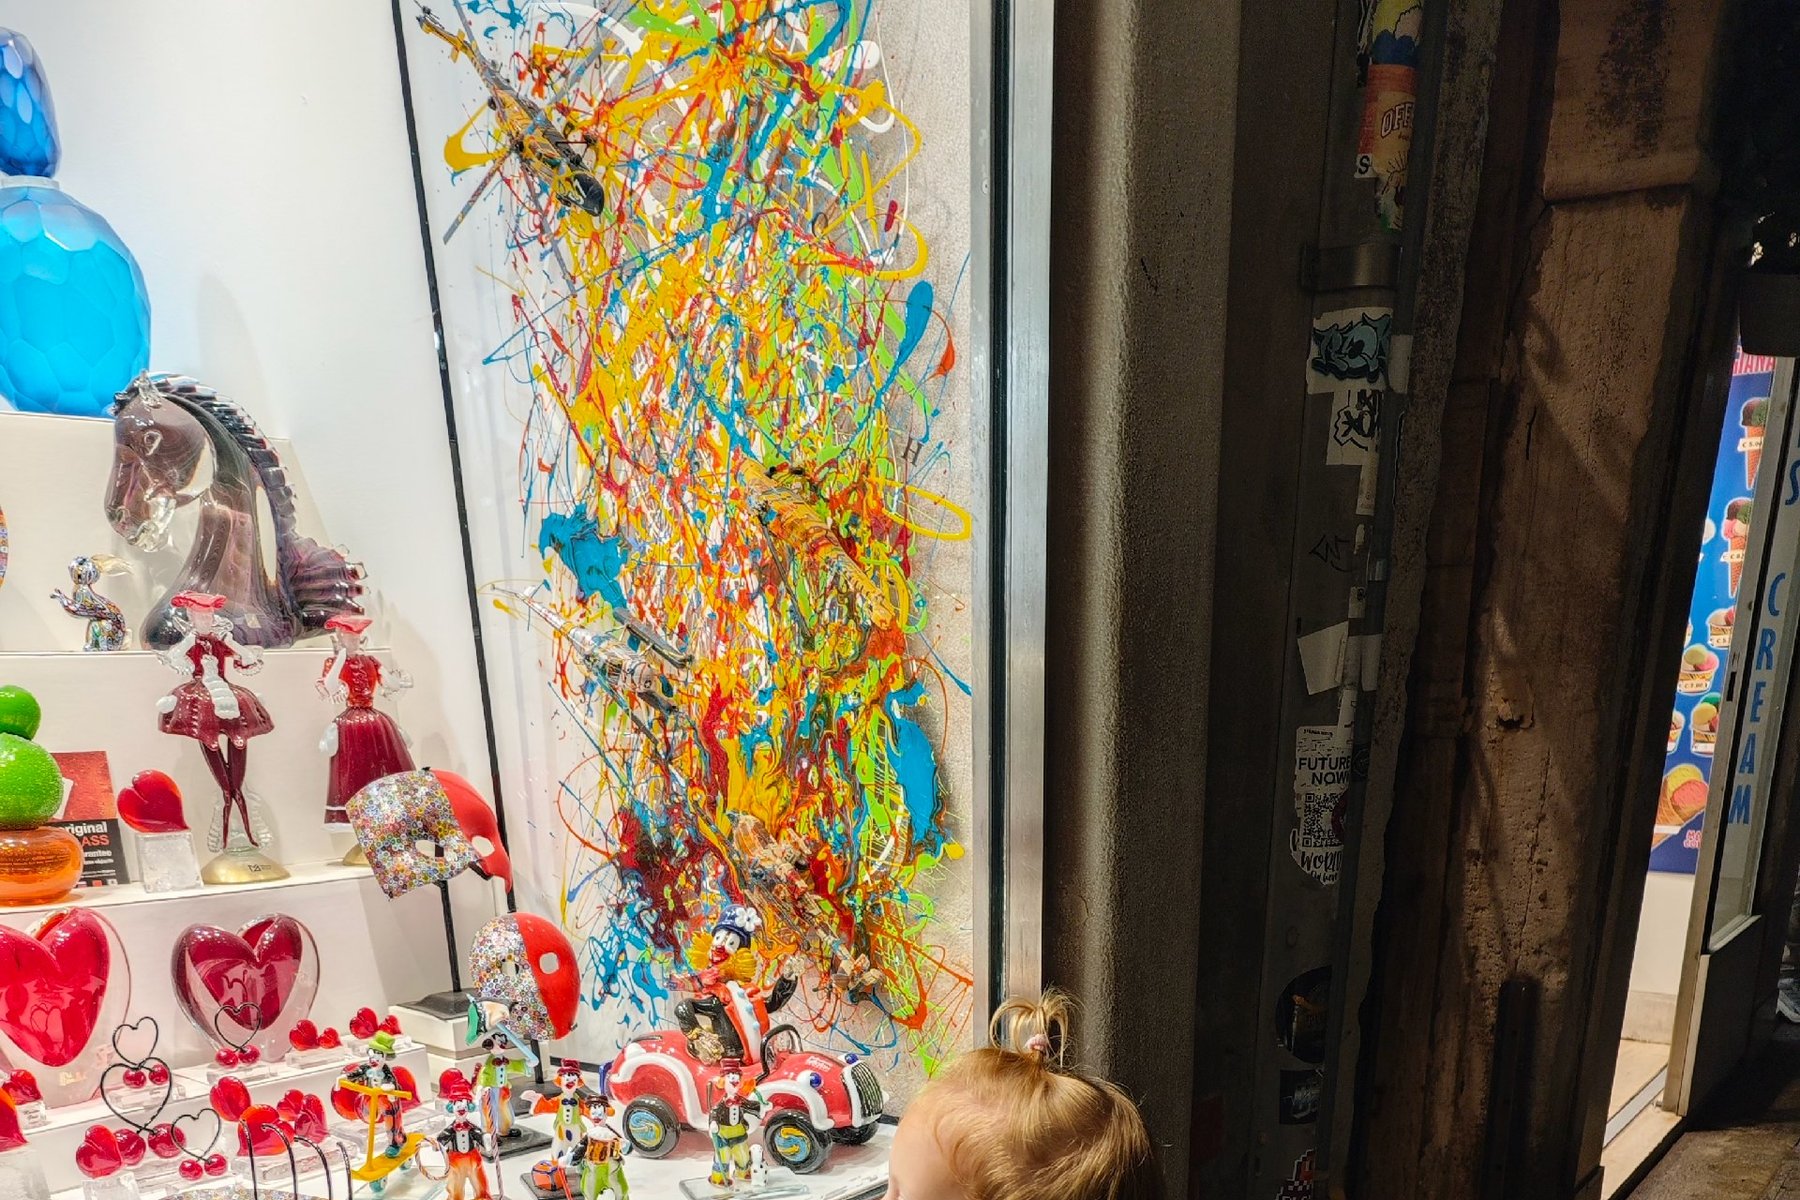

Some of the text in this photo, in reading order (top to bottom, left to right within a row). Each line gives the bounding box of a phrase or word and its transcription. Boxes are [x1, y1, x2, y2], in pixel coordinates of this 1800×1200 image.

[1727, 571, 1786, 825] CREAM
[66, 821, 107, 836] riginal
[82, 834, 109, 846] ASS
